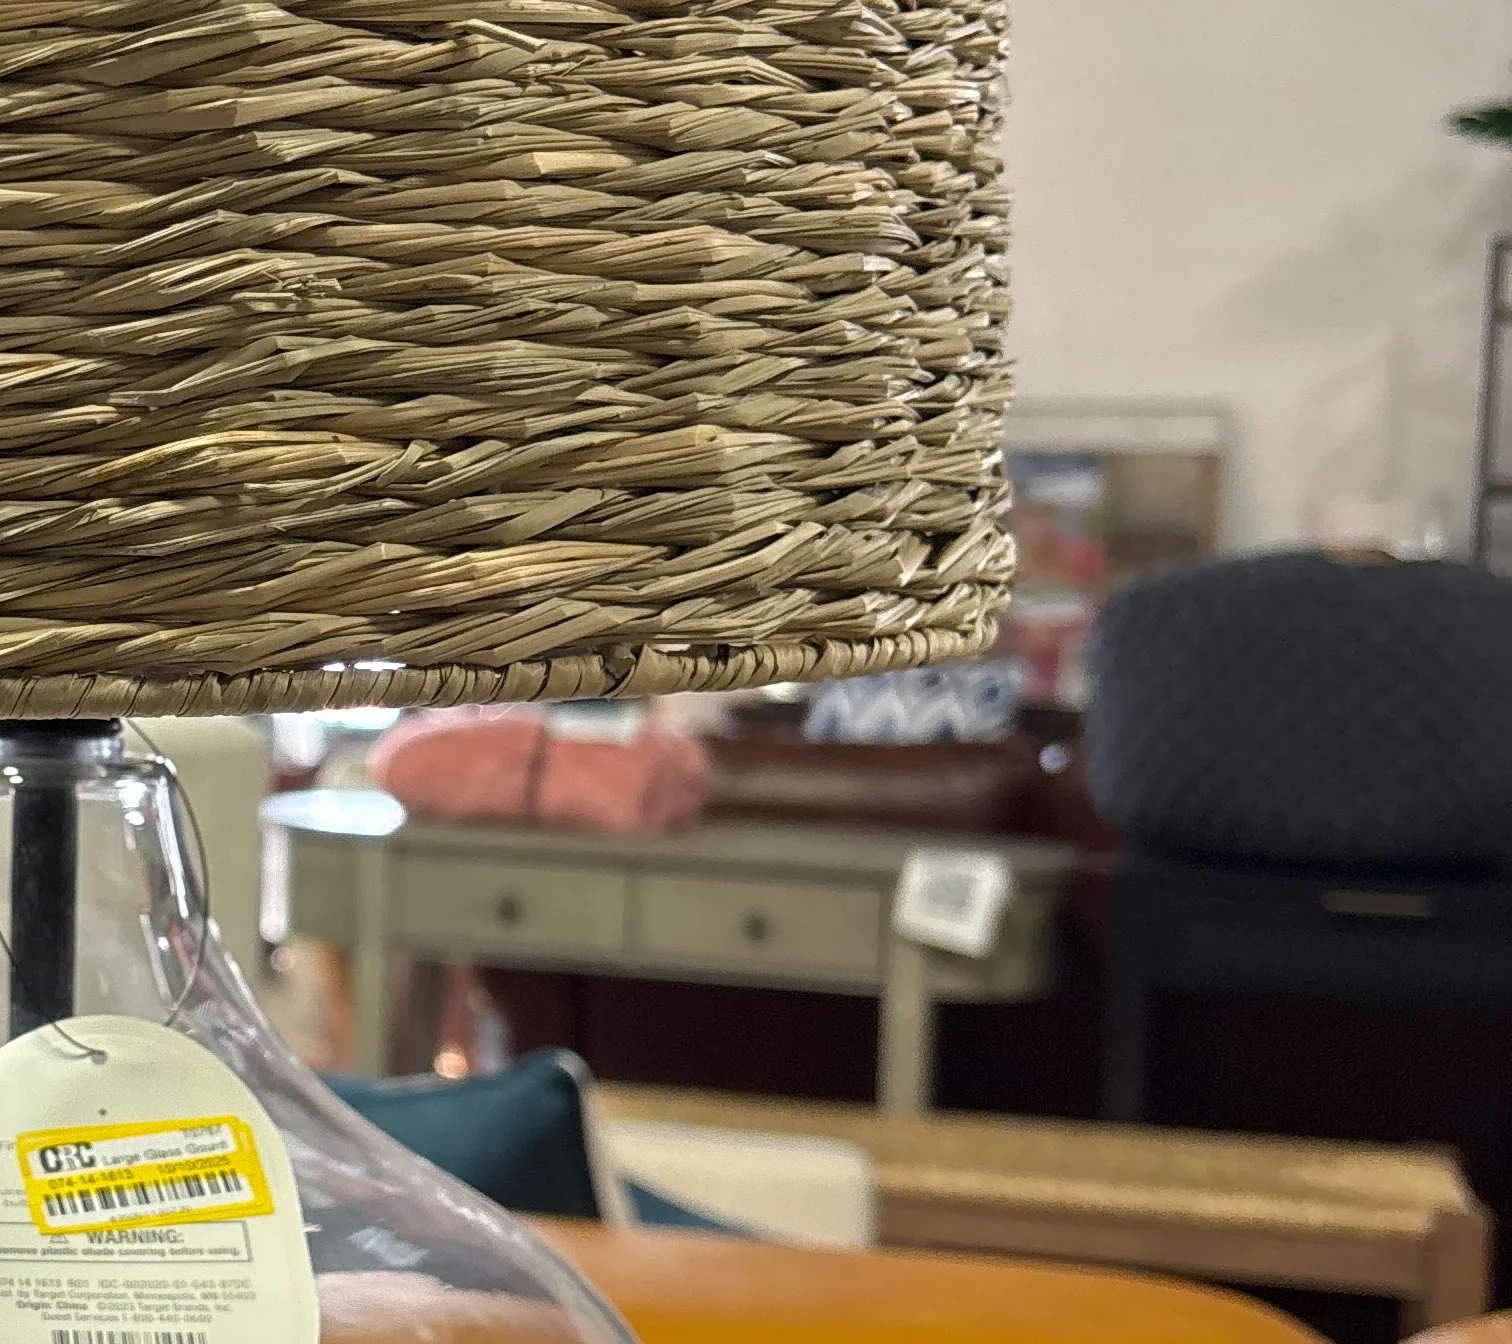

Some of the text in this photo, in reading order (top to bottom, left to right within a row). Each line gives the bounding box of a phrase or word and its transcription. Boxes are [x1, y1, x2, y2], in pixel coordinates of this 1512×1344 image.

[101, 1153, 141, 1165] Large
[143, 1148, 182, 1160] Glass
[185, 1139, 228, 1153] Gourd
[87, 1230, 183, 1244] WARNING:
